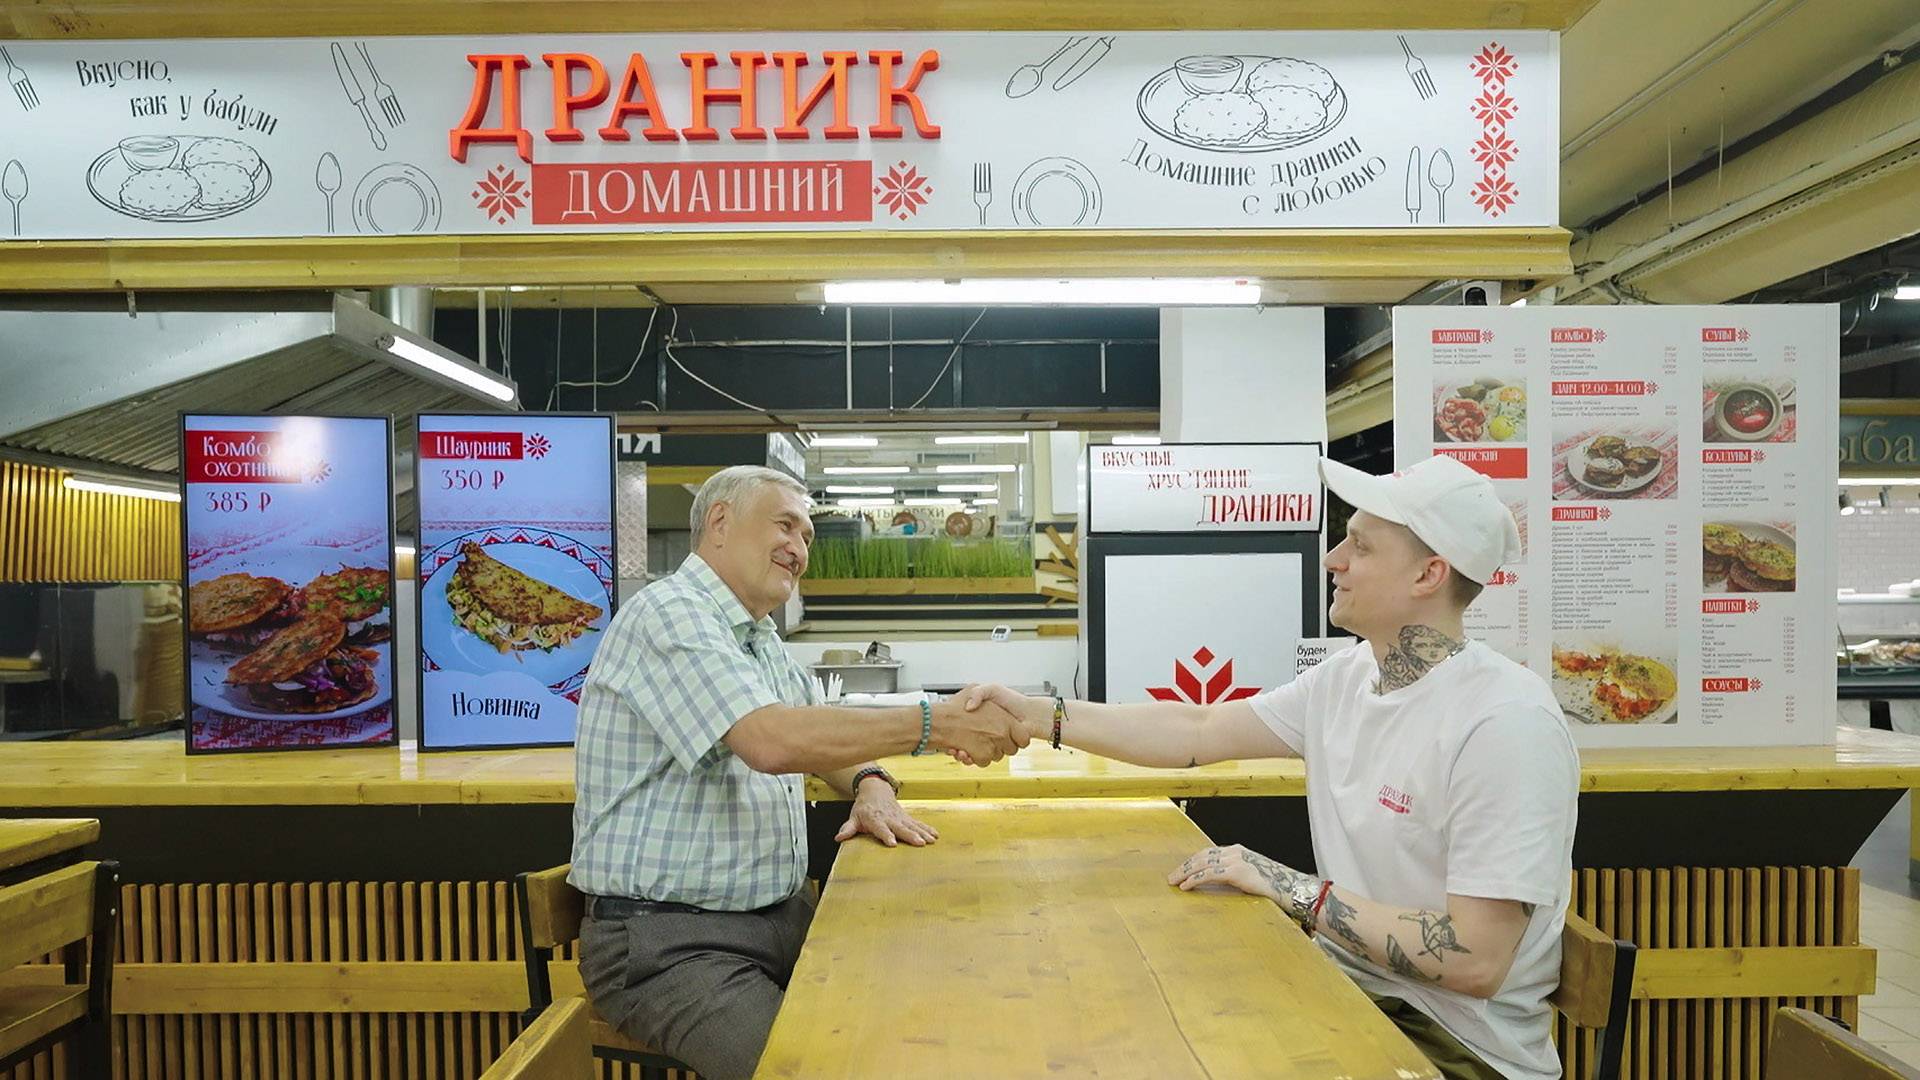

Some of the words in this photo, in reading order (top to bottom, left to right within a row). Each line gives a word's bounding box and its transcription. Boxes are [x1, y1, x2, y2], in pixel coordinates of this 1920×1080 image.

[76, 59, 172, 87] Вкусно,
[130, 94, 168, 117] как
[180, 95, 191, 121] у
[203, 89, 278, 136] бабули
[449, 49, 941, 164] ДРАНИК
[1121, 138, 1256, 186] Домашние
[1270, 136, 1362, 187] драники
[561, 163, 843, 221] ДОМАШНИЙ
[1274, 156, 1386, 214] любовью
[1439, 331, 1478, 342] ЗАВТРАКИ
[1554, 331, 1590, 341] КОМБО
[203, 435, 272, 457] Комбо
[436, 435, 512, 460] Шаурник
[1102, 451, 1175, 467] ВКУСНЫЕ
[441, 469, 482, 490] 350
[1148, 469, 1252, 490] ХРУСТЯЩИЕ
[205, 491, 248, 513] 385
[1196, 494, 1313, 527] ДРАНИКИ
[1297, 645, 1327, 657] будем
[1705, 680, 1743, 691] СОУСЫ
[452, 692, 541, 720] Новинка
